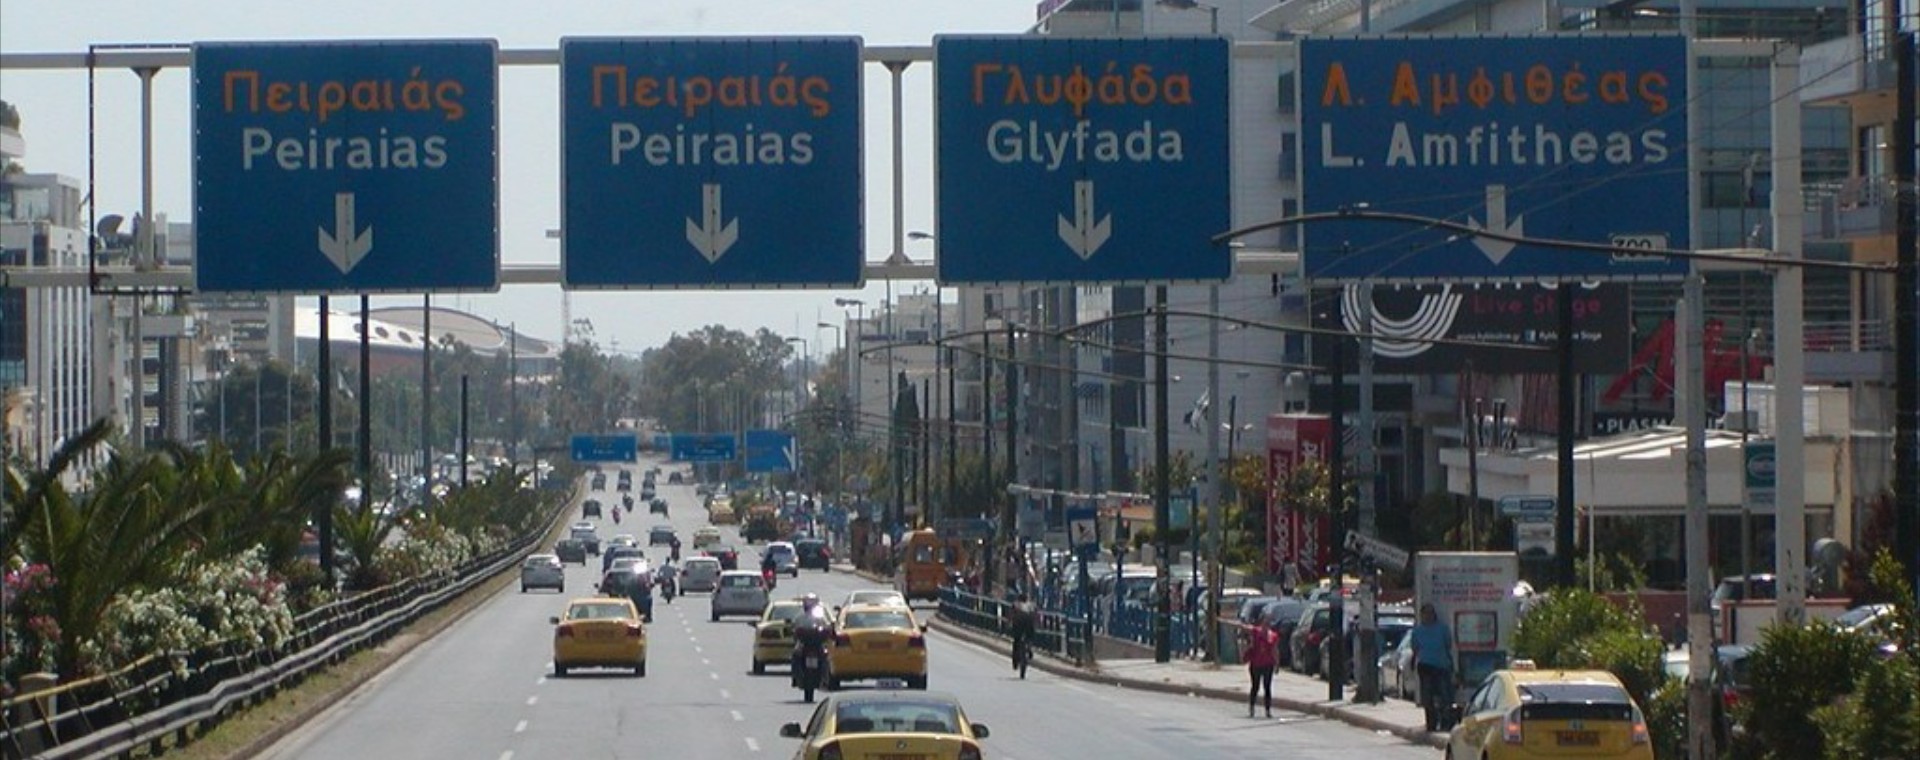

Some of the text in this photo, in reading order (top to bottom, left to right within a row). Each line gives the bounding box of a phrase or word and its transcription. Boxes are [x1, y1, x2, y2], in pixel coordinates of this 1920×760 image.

[223, 67, 465, 121] Πειραιάς
[592, 62, 831, 119] Πειραιάς
[971, 62, 1193, 118] Γλυφάδα
[1391, 62, 1669, 114] Αμφιθέας
[242, 127, 448, 170] Peiraias
[611, 122, 814, 165] Peiraias
[986, 119, 1184, 170] Glyfada
[1321, 122, 1669, 168] L. Amfitheas
[1471, 294, 1601, 318] Live Stge
